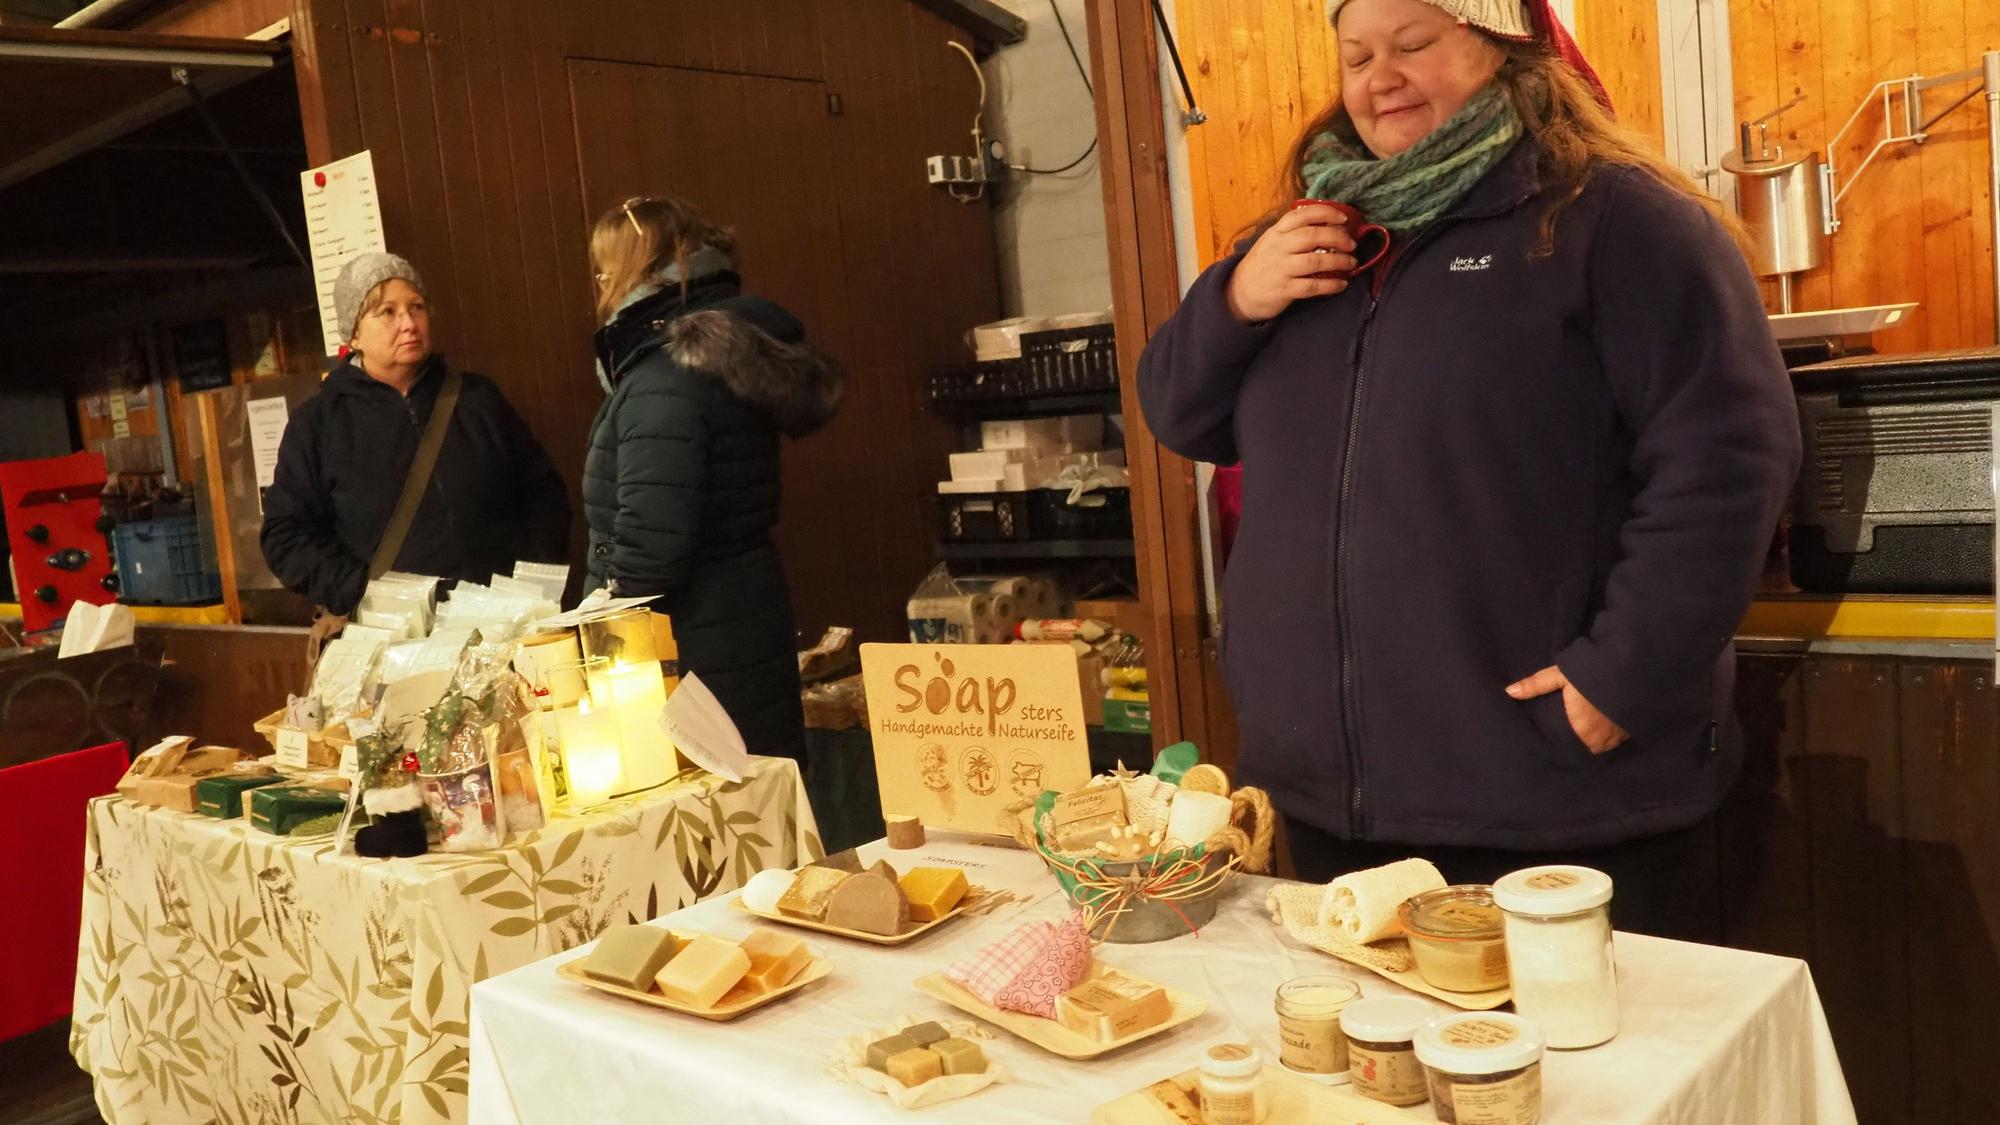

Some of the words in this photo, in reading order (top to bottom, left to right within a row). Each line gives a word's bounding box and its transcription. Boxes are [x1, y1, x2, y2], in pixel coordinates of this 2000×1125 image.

[894, 663, 1017, 736] Soap
[1021, 704, 1063, 722] sters
[881, 718, 984, 739] Handgemachte
[998, 723, 1076, 741] Naturseife
[1067, 794, 1103, 808] Felicitas
